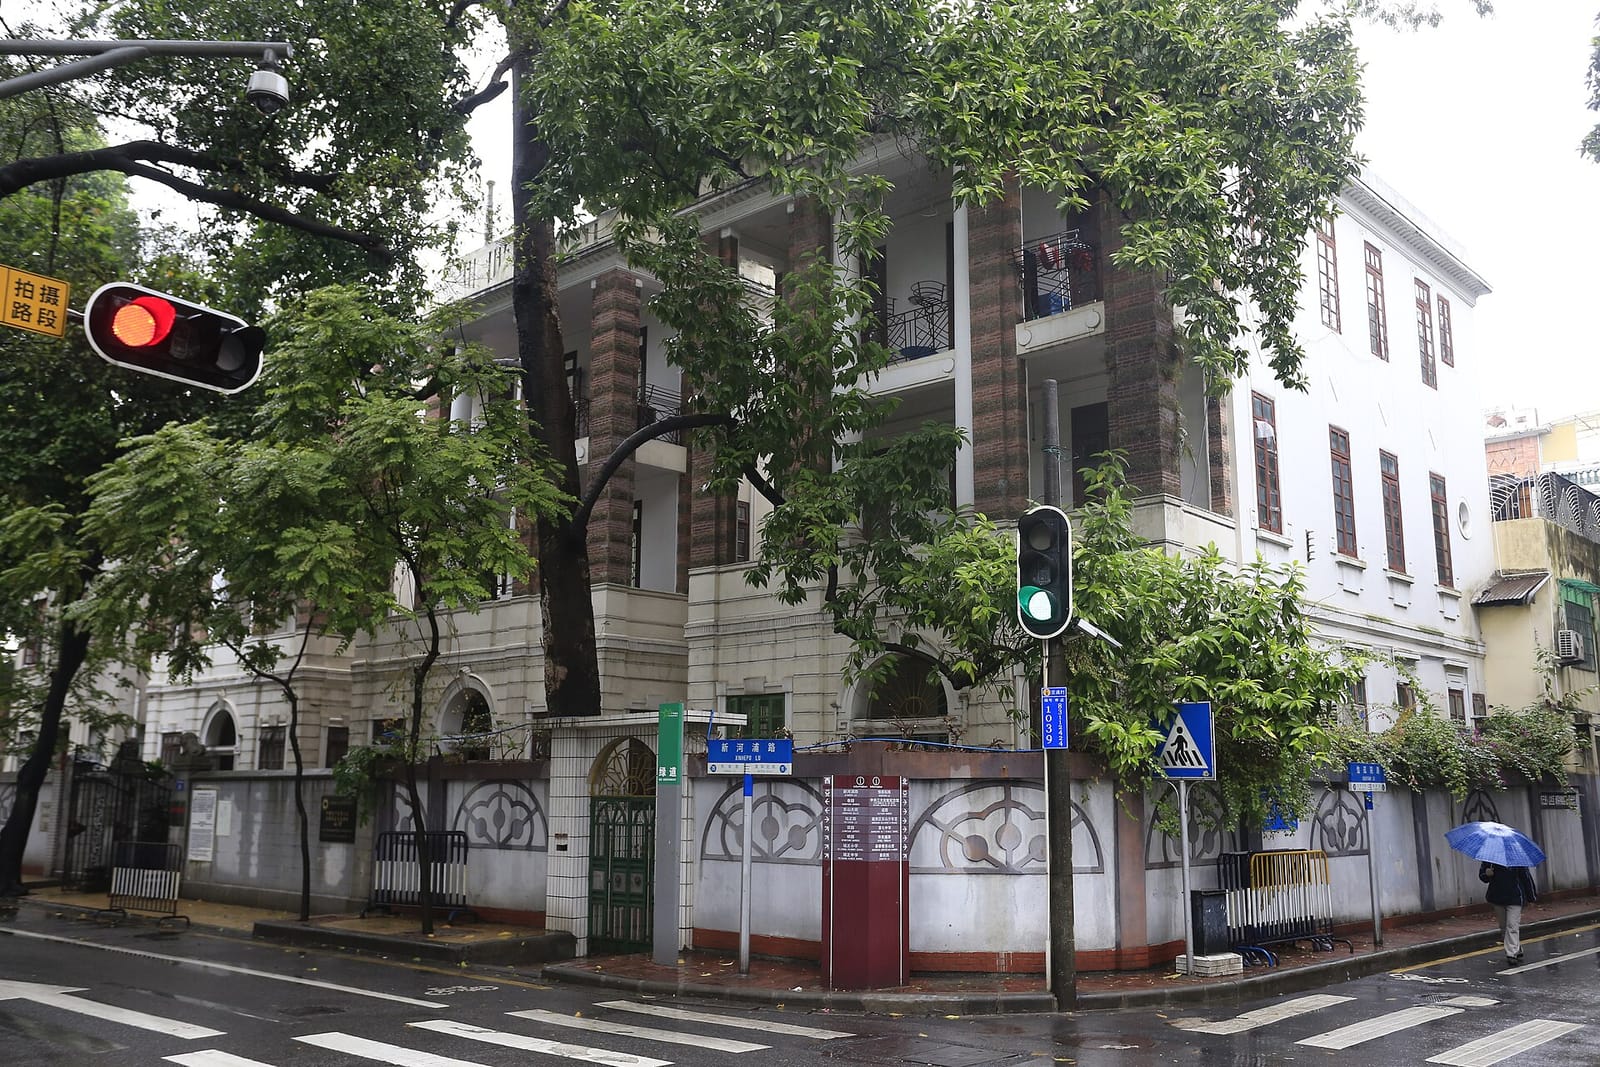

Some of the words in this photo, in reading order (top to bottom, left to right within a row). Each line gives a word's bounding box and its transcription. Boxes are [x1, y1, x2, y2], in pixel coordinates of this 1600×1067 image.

[14, 278, 61, 306] 拍摄
[11, 301, 57, 329] 路段
[1045, 705, 1053, 744] 1039
[721, 742, 776, 753] 新河浦路
[658, 766, 677, 777] 绿道
